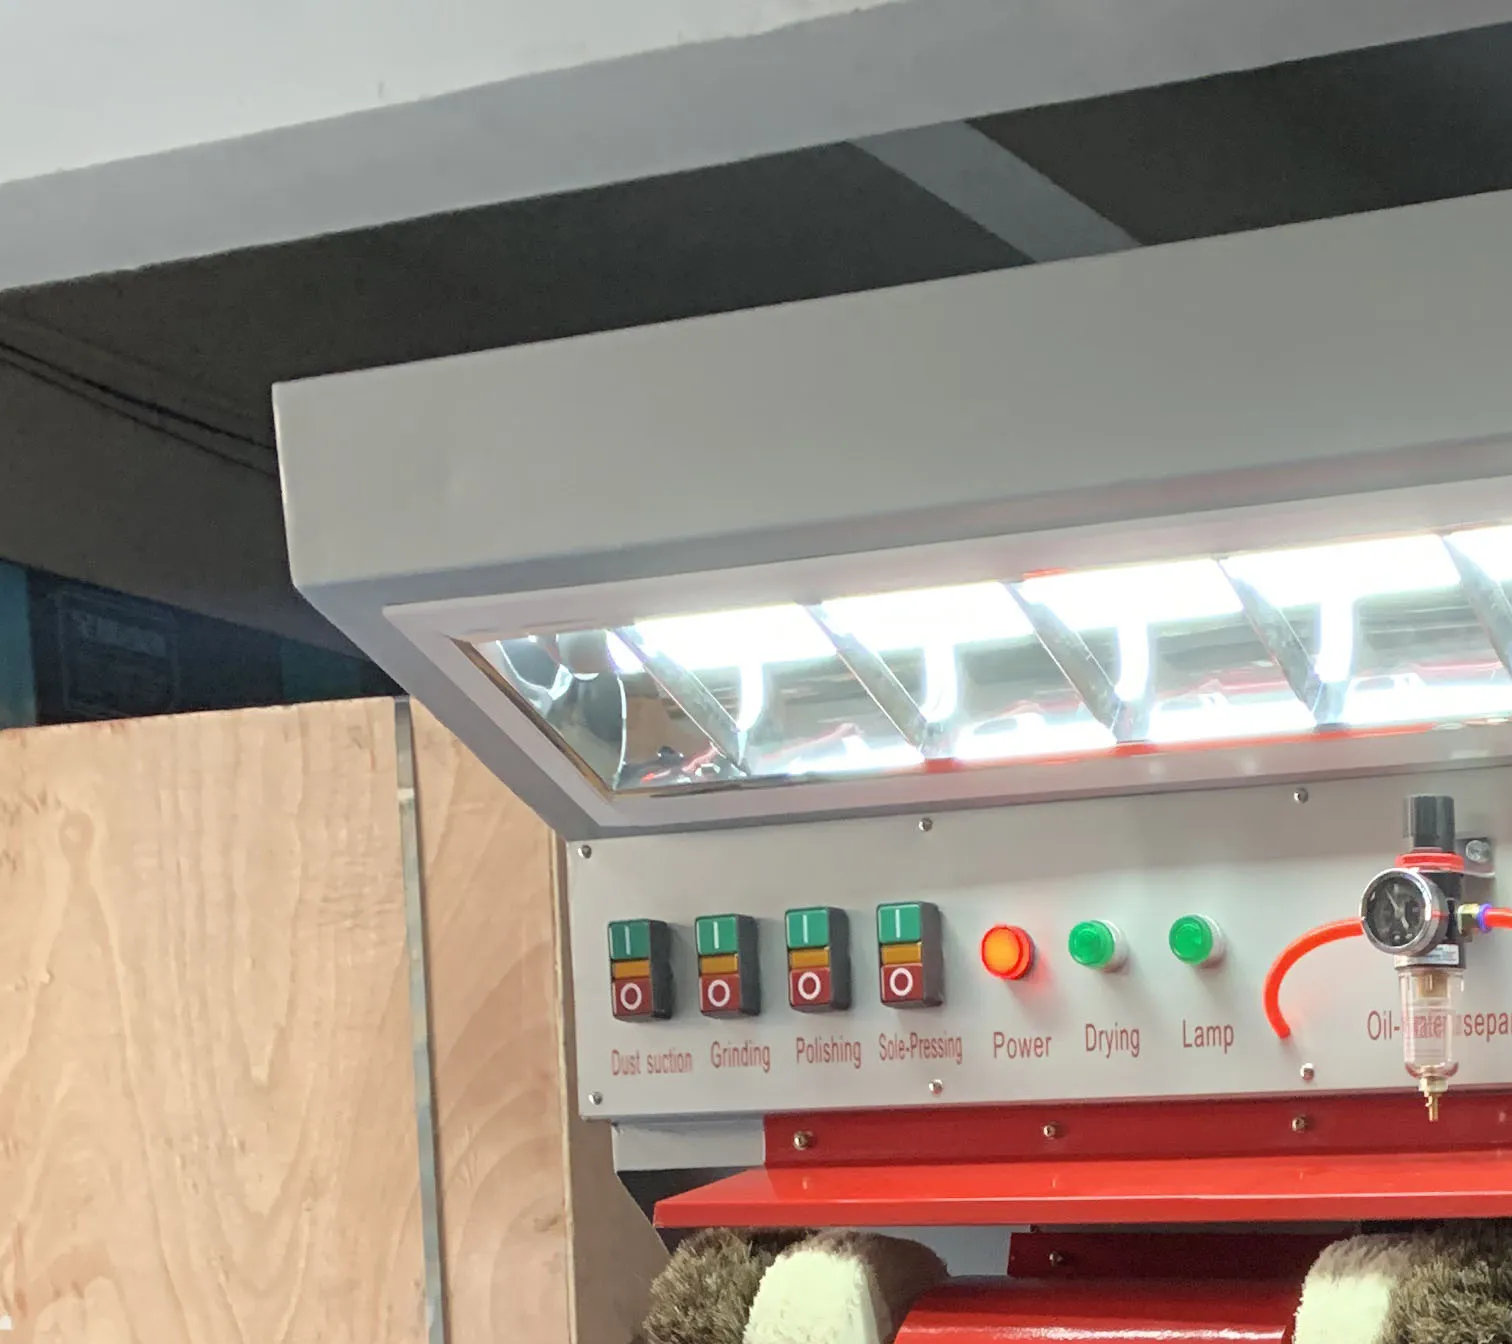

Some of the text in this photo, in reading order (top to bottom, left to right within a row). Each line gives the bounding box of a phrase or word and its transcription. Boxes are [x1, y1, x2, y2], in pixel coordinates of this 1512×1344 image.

[796, 1036, 861, 1069] Polishing
[878, 1031, 963, 1065] Sole-Pressing
[993, 1031, 1052, 1059] Power
[1085, 1022, 1141, 1058] Drying
[1182, 1019, 1235, 1054] Lamp
[611, 1048, 693, 1076] Dust suction
[710, 1040, 771, 1073] Grinding
